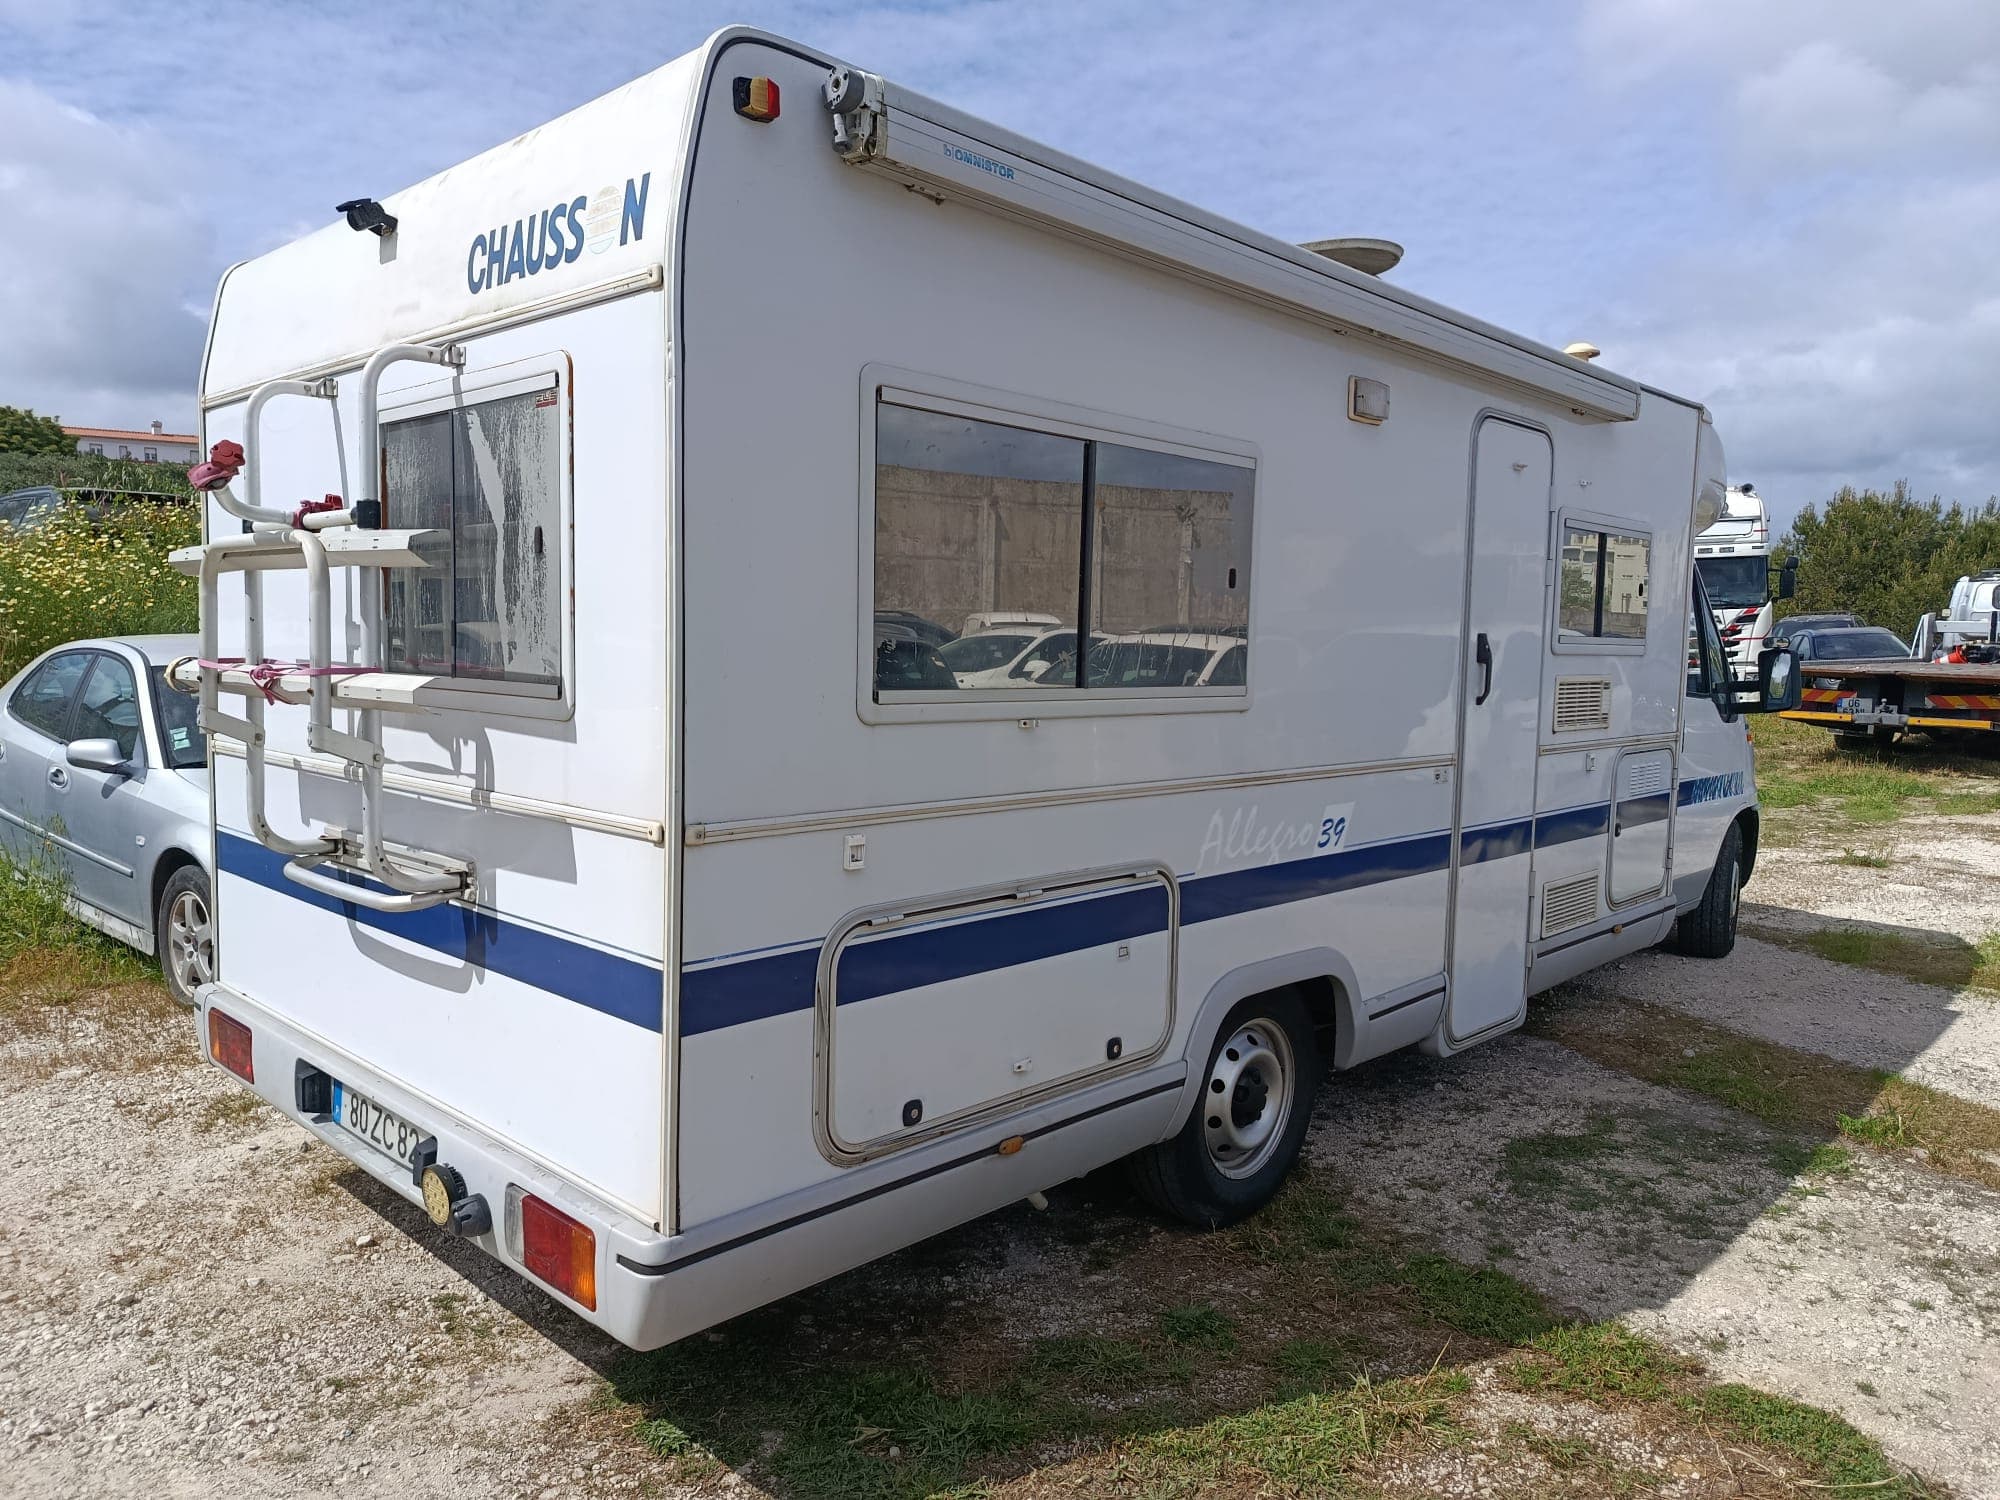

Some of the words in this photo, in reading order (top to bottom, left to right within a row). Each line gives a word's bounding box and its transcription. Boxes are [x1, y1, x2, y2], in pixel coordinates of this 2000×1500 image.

[954, 148, 1015, 180] OMNISTOR
[1196, 804, 1315, 873] Allegro
[1317, 816, 1346, 849] 39
